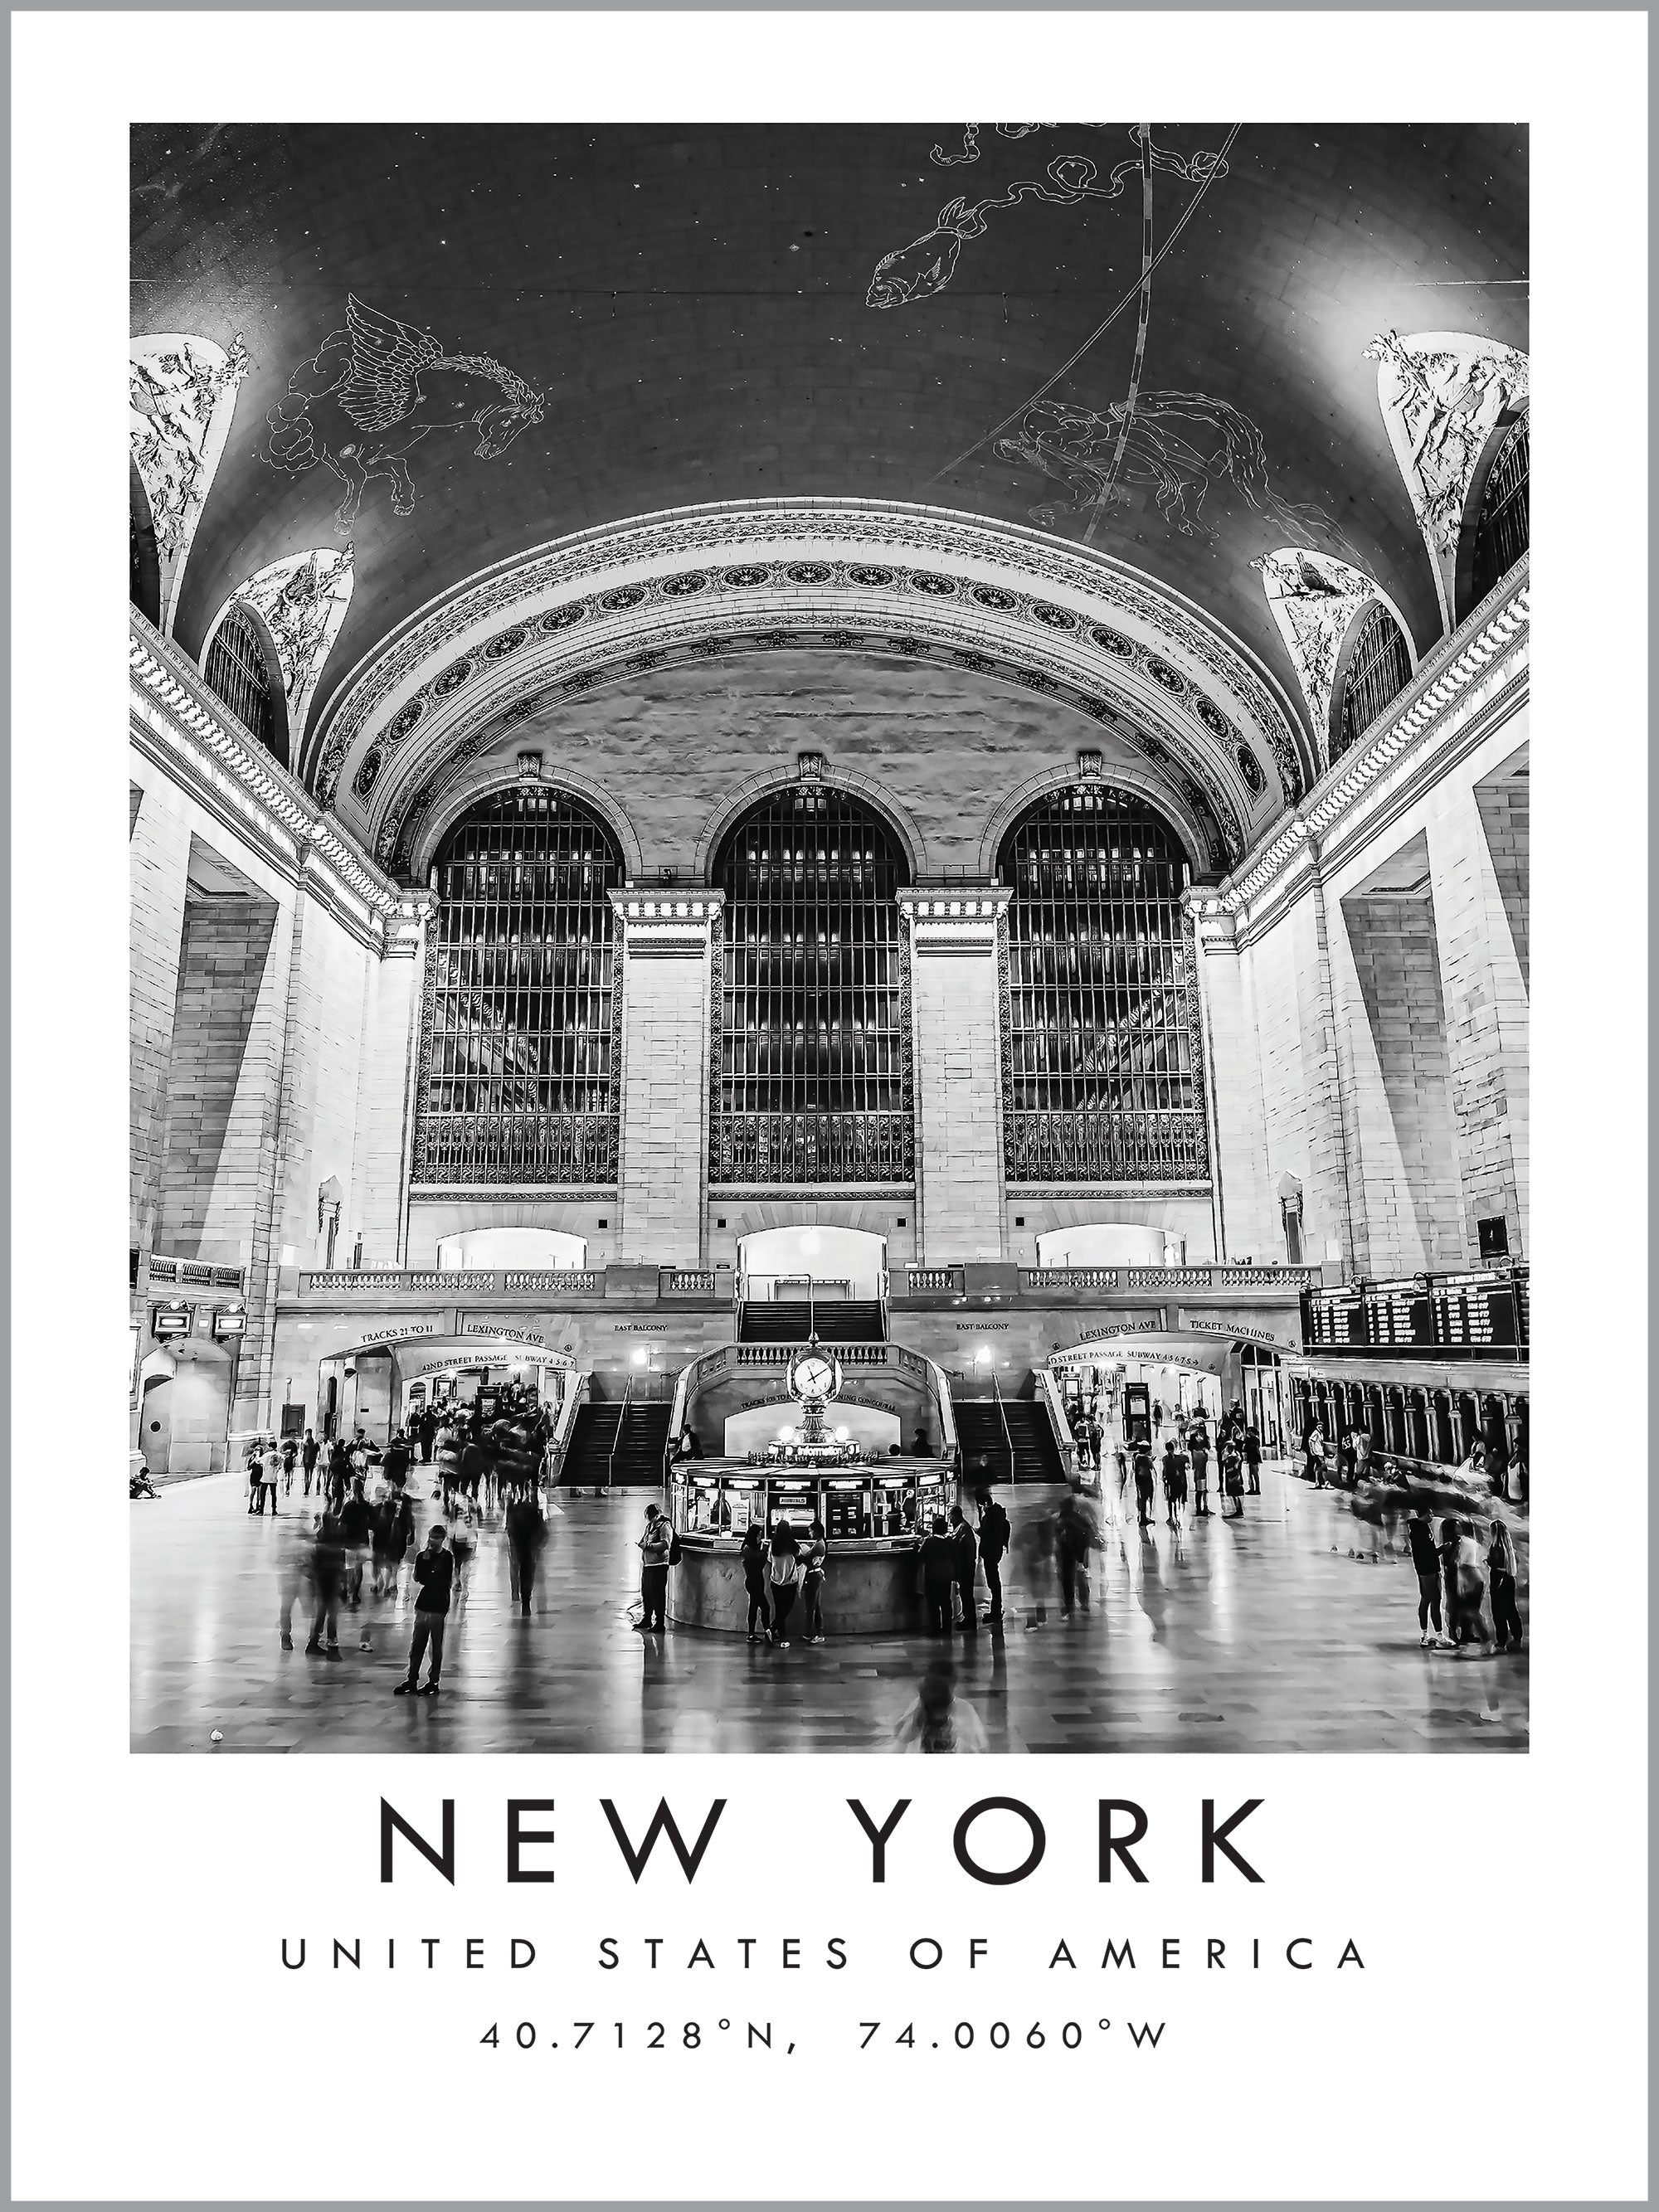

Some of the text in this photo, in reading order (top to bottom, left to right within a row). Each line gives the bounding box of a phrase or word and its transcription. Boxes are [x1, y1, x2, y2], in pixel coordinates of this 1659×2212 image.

[361, 1329, 398, 1342] TRACKS
[400, 1328, 407, 1336] 21
[411, 1325, 424, 1334] TO
[467, 1324, 545, 1343] LEXINGTON AVE
[1079, 1320, 1156, 1341] LEXINGTON AVE
[1190, 1320, 1275, 1342] TICKET MACHINES
[422, 1354, 508, 1371] 42ND STREET PASSAGE
[1058, 1353, 1087, 1363] STREET
[1089, 1351, 1122, 1359] PASSAGE
[1126, 1350, 1161, 1360] SUBWAY
